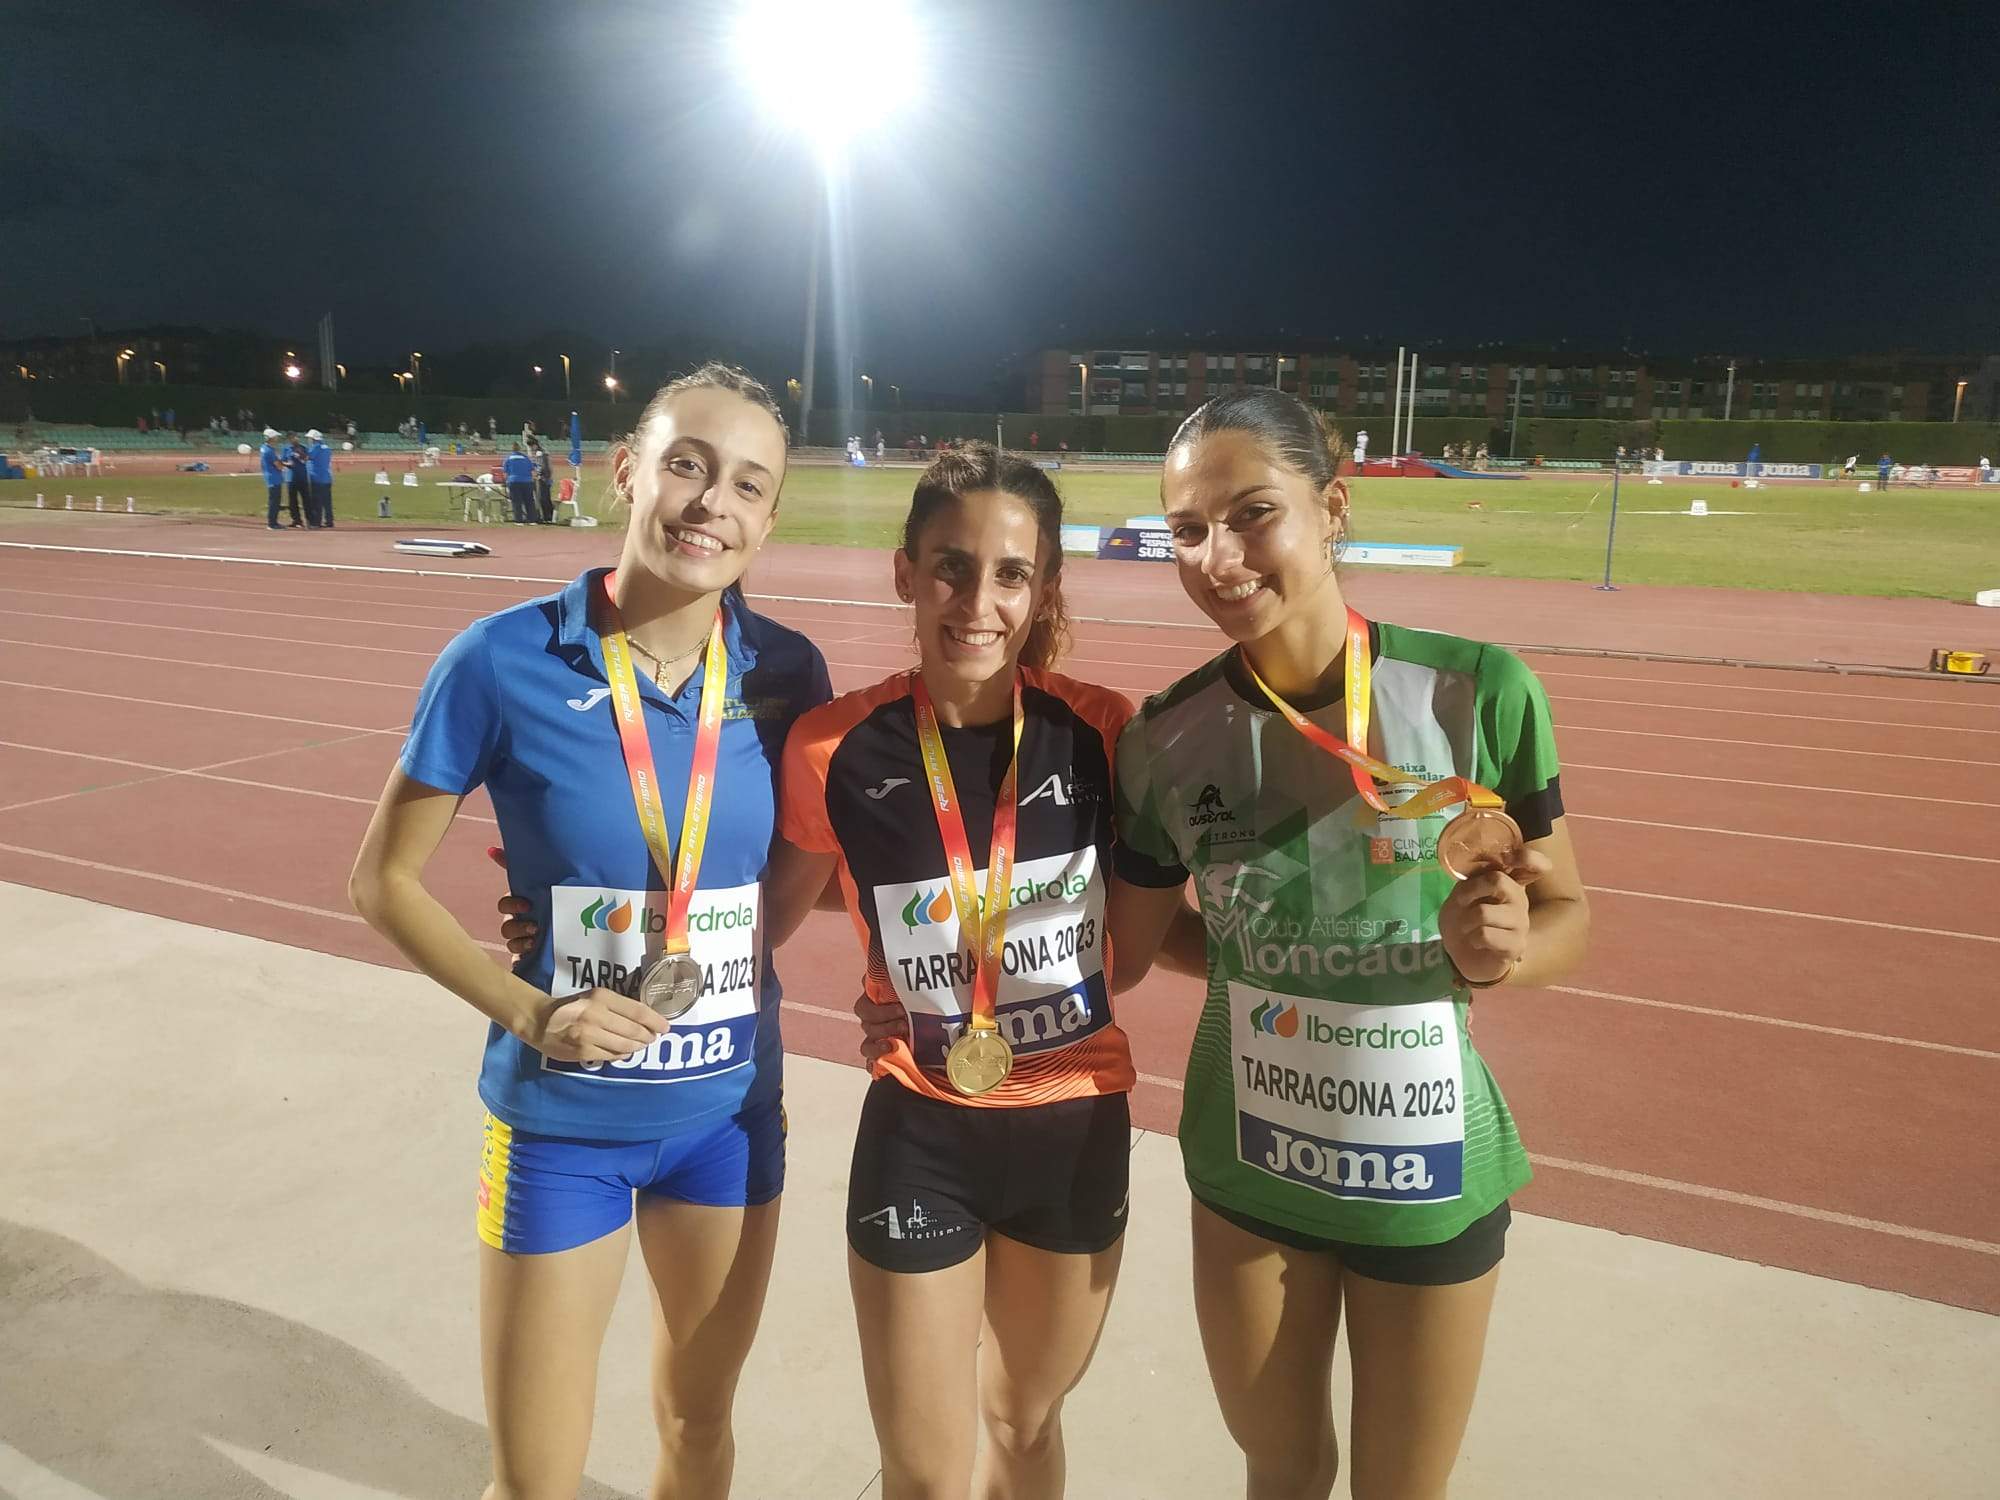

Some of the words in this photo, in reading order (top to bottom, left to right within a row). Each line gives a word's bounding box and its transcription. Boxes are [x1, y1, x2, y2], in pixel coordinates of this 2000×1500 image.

[1361, 550, 1369, 559] 3
[640, 902, 753, 934] Ibrdrola
[1252, 917, 1302, 939] Club
[898, 935, 1054, 992] TARRAONA
[1054, 918, 1096, 961] 2023
[567, 956, 715, 1003] TARRAA
[719, 955, 757, 994] 2023
[1306, 1014, 1444, 1049] Iberdrola
[1241, 1055, 1397, 1118] TARRAGONA
[1403, 1077, 1457, 1118] 2023
[1265, 1128, 1434, 1191] Joma
